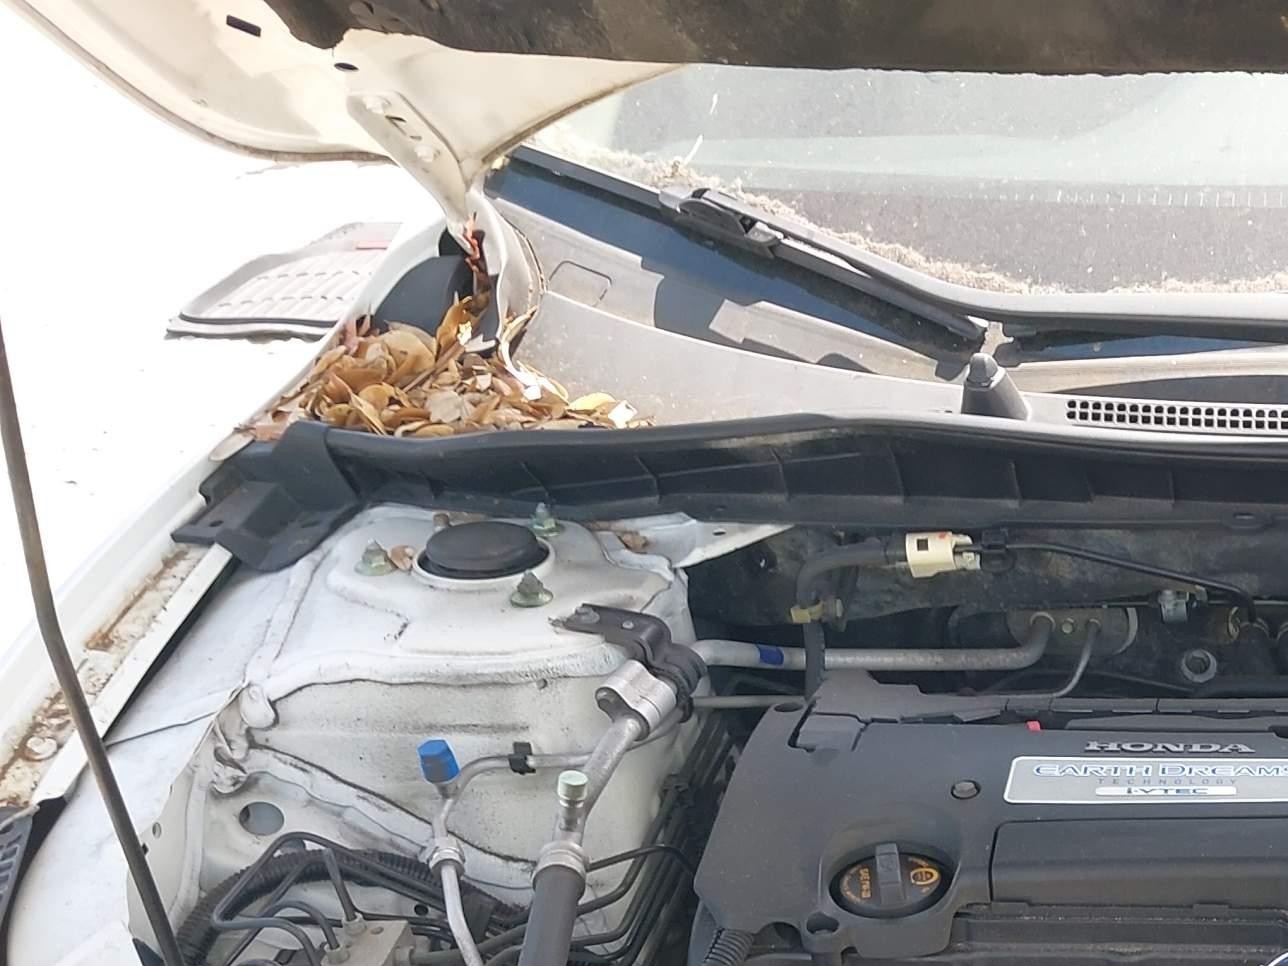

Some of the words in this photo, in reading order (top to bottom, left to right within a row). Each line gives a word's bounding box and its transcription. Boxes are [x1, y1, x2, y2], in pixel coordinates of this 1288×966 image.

[1084, 740, 1256, 753] HONDA
[1032, 762, 1154, 778] EARTH
[1126, 787, 1208, 795] i-VTEC
